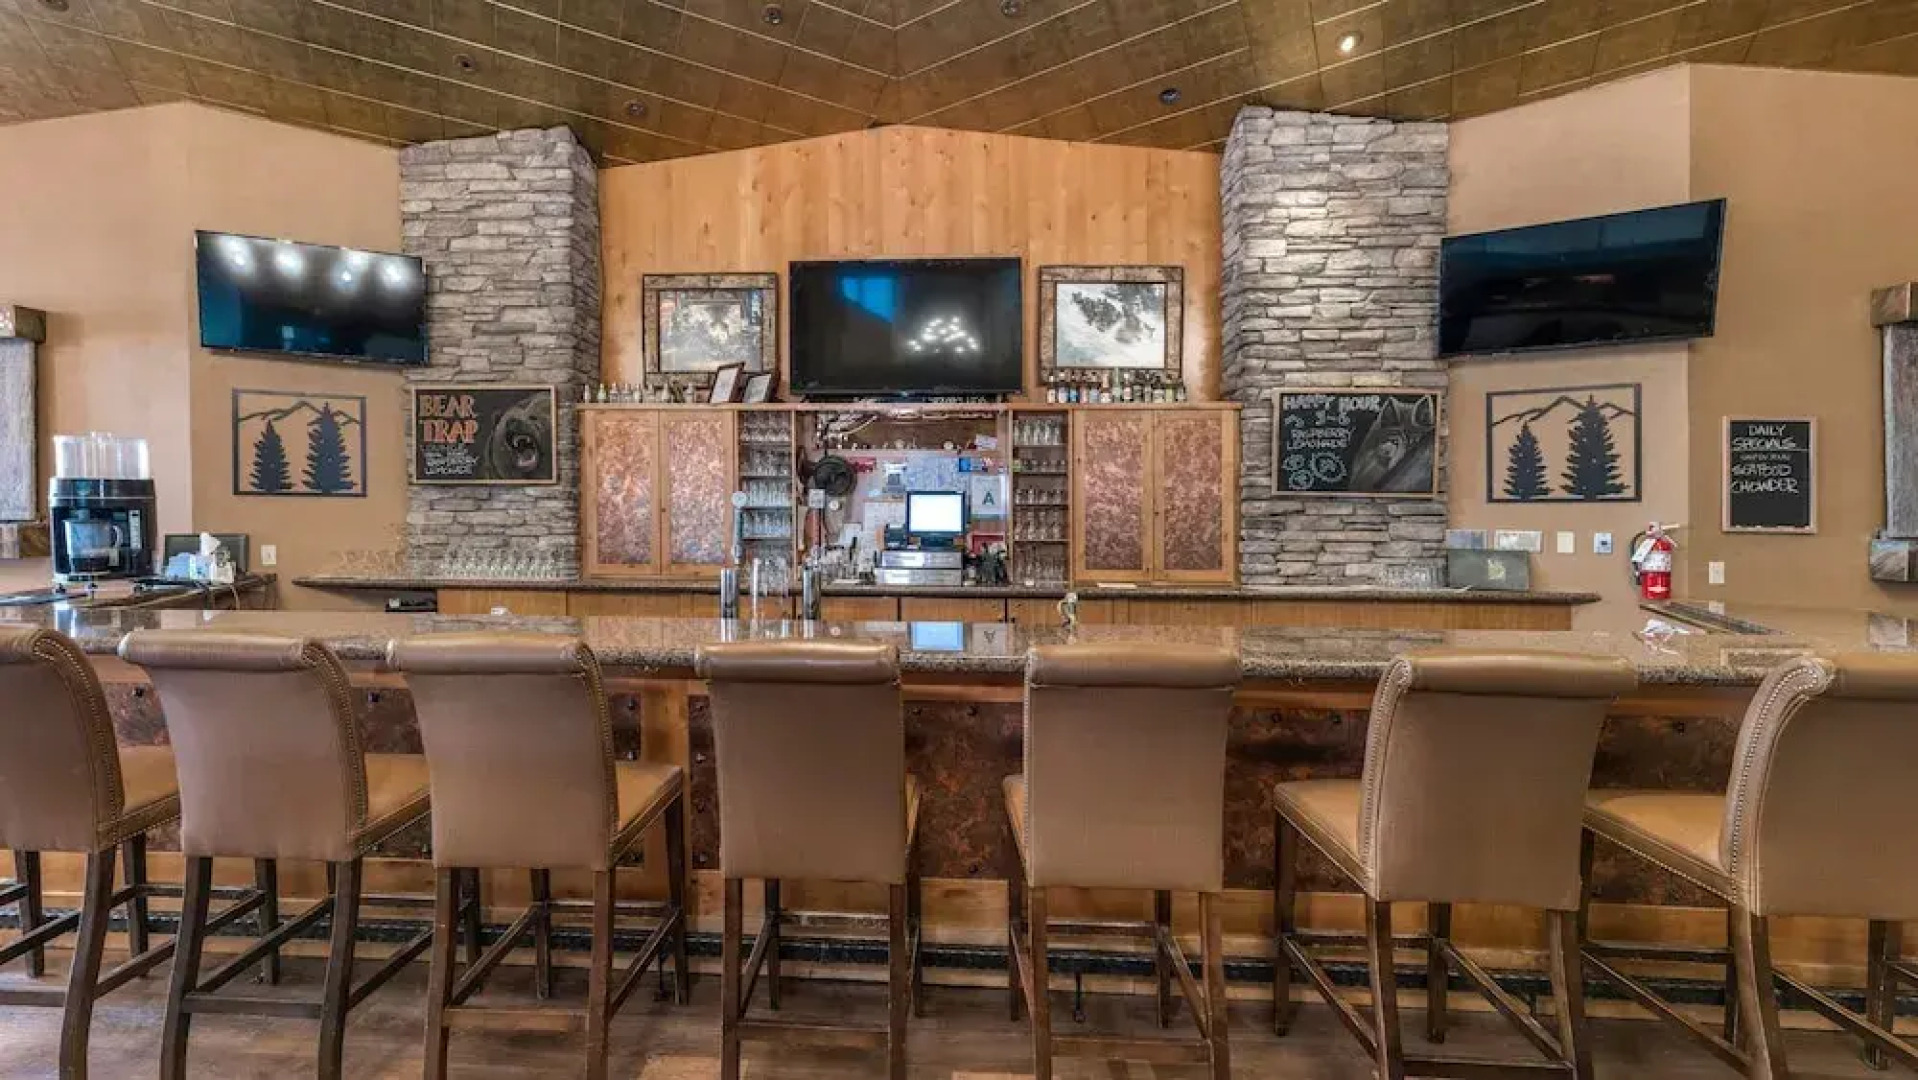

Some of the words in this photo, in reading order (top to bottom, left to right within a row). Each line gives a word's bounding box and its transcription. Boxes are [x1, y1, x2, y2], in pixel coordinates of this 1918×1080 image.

[419, 394, 477, 418] BEAR
[1282, 395, 1336, 411] HAPPY
[1338, 395, 1380, 412] HOUR
[419, 419, 478, 443] TRAP
[1748, 424, 1787, 436] DAILY
[1732, 437, 1797, 451] SPECIALS
[1732, 463, 1793, 477] SEAFOOD
[1731, 478, 1800, 494] CHOWDER
[982, 490, 996, 505] A
